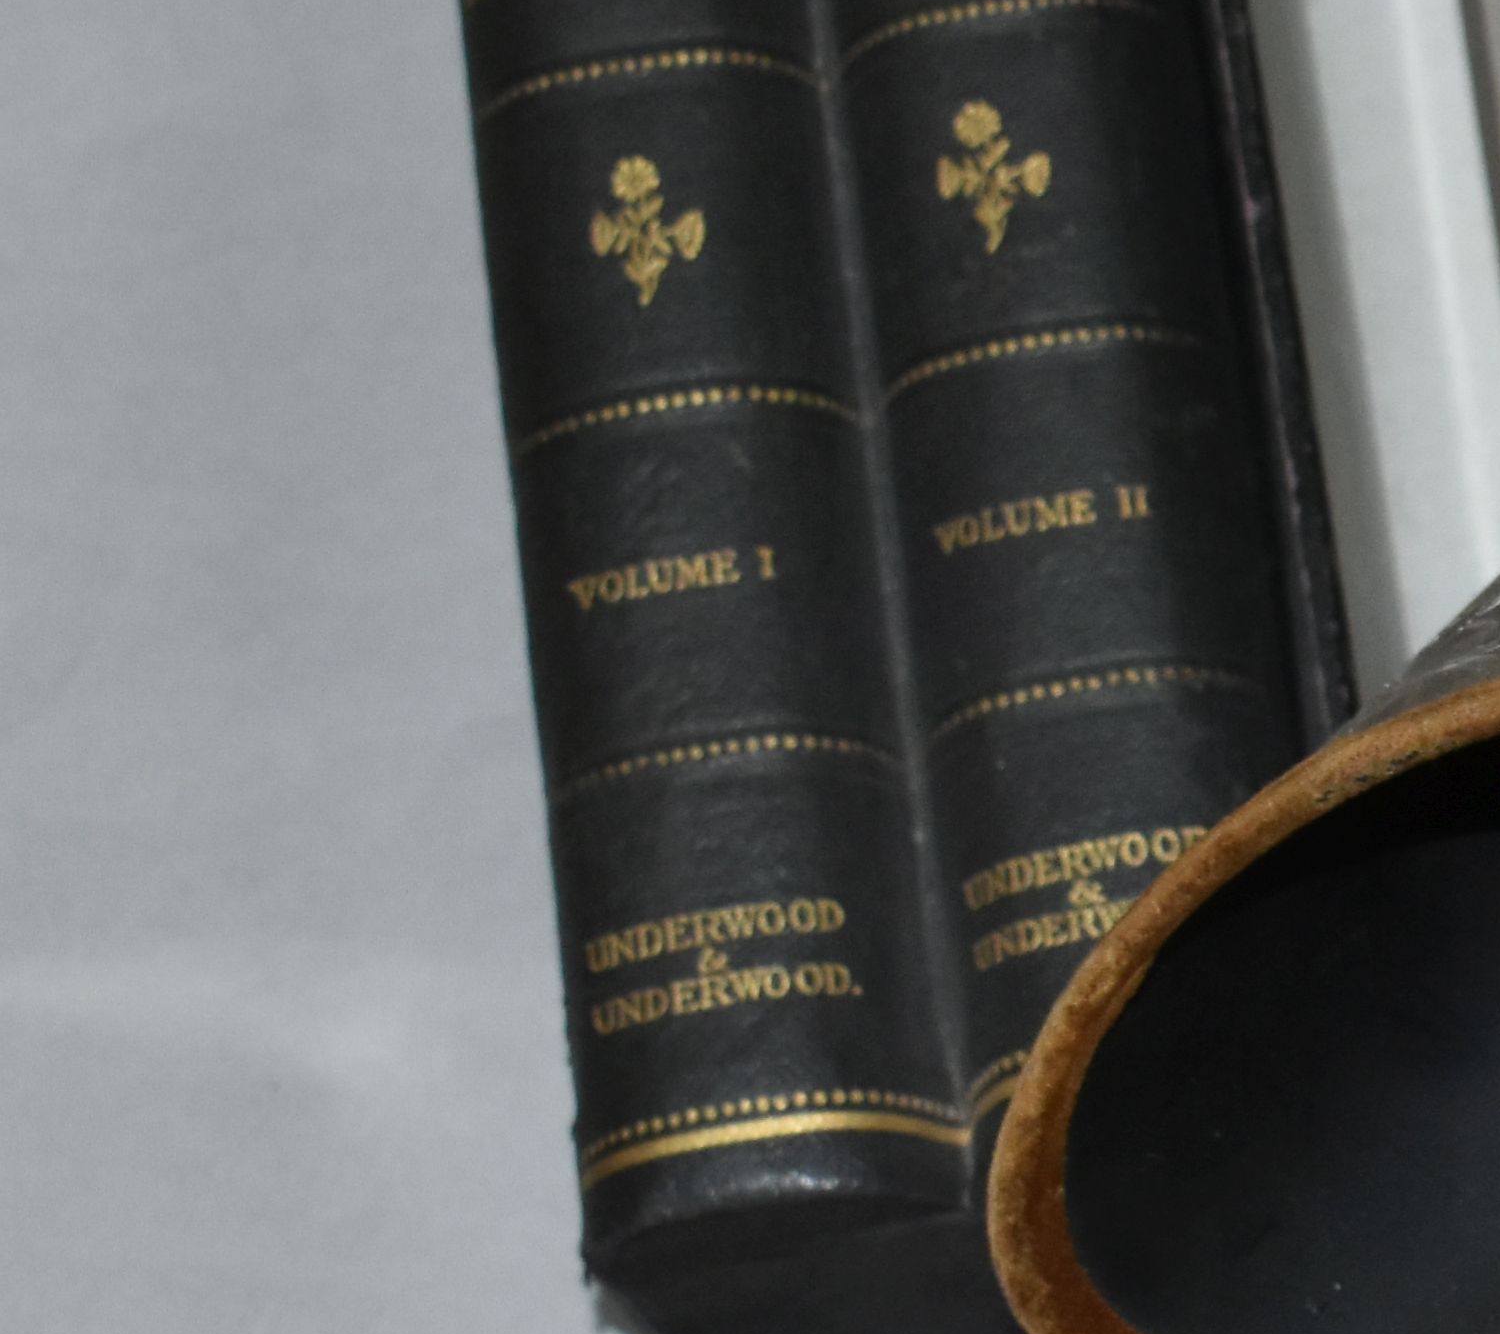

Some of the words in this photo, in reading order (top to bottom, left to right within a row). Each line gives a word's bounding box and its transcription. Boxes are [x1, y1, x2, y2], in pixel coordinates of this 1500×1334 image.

[934, 489, 1097, 556] VOLUME
[1117, 485, 1149, 520] II
[568, 547, 742, 610] VOLUME
[755, 544, 776, 581] I
[1068, 878, 1107, 908] &
[586, 897, 846, 973] UNDERWOOD
[697, 947, 729, 975] &
[592, 962, 863, 1036] UNDERWOOD.
